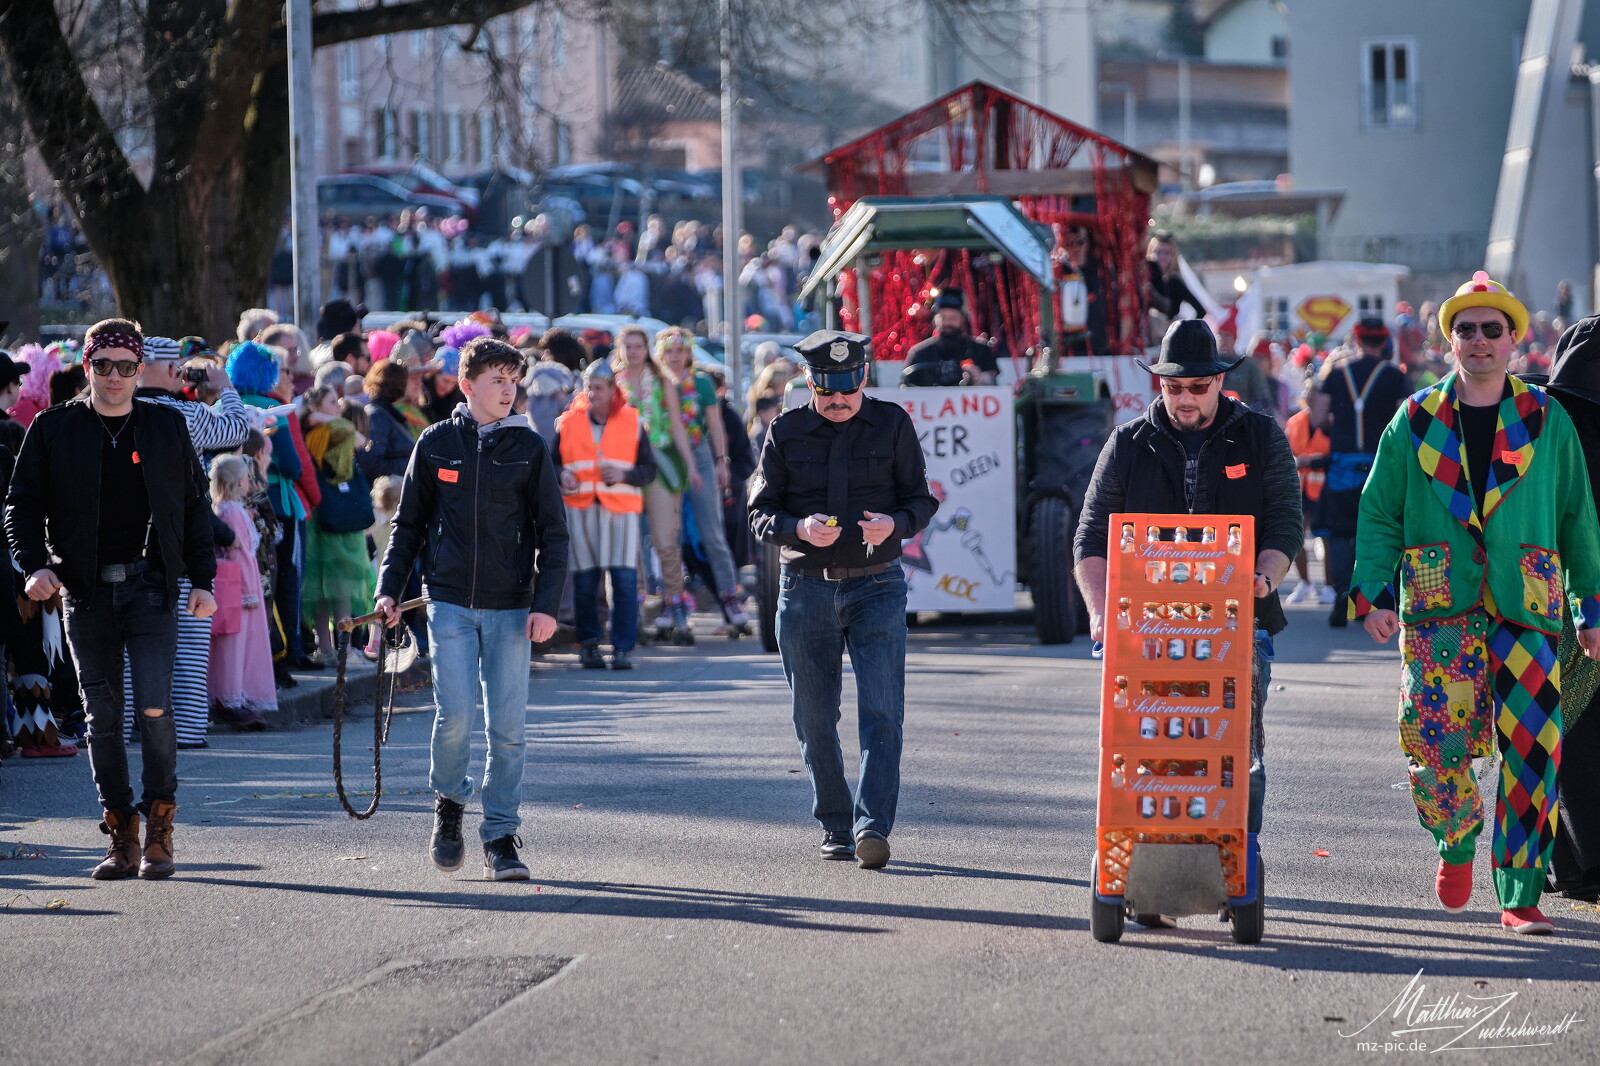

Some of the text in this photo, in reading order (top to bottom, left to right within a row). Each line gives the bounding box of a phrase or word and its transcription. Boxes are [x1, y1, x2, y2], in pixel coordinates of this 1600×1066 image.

[1134, 543, 1226, 559] Schönramer
[1131, 619, 1223, 636] Schönramer
[1127, 697, 1220, 715] Schönramer
[1124, 776, 1218, 793] Schönramer
